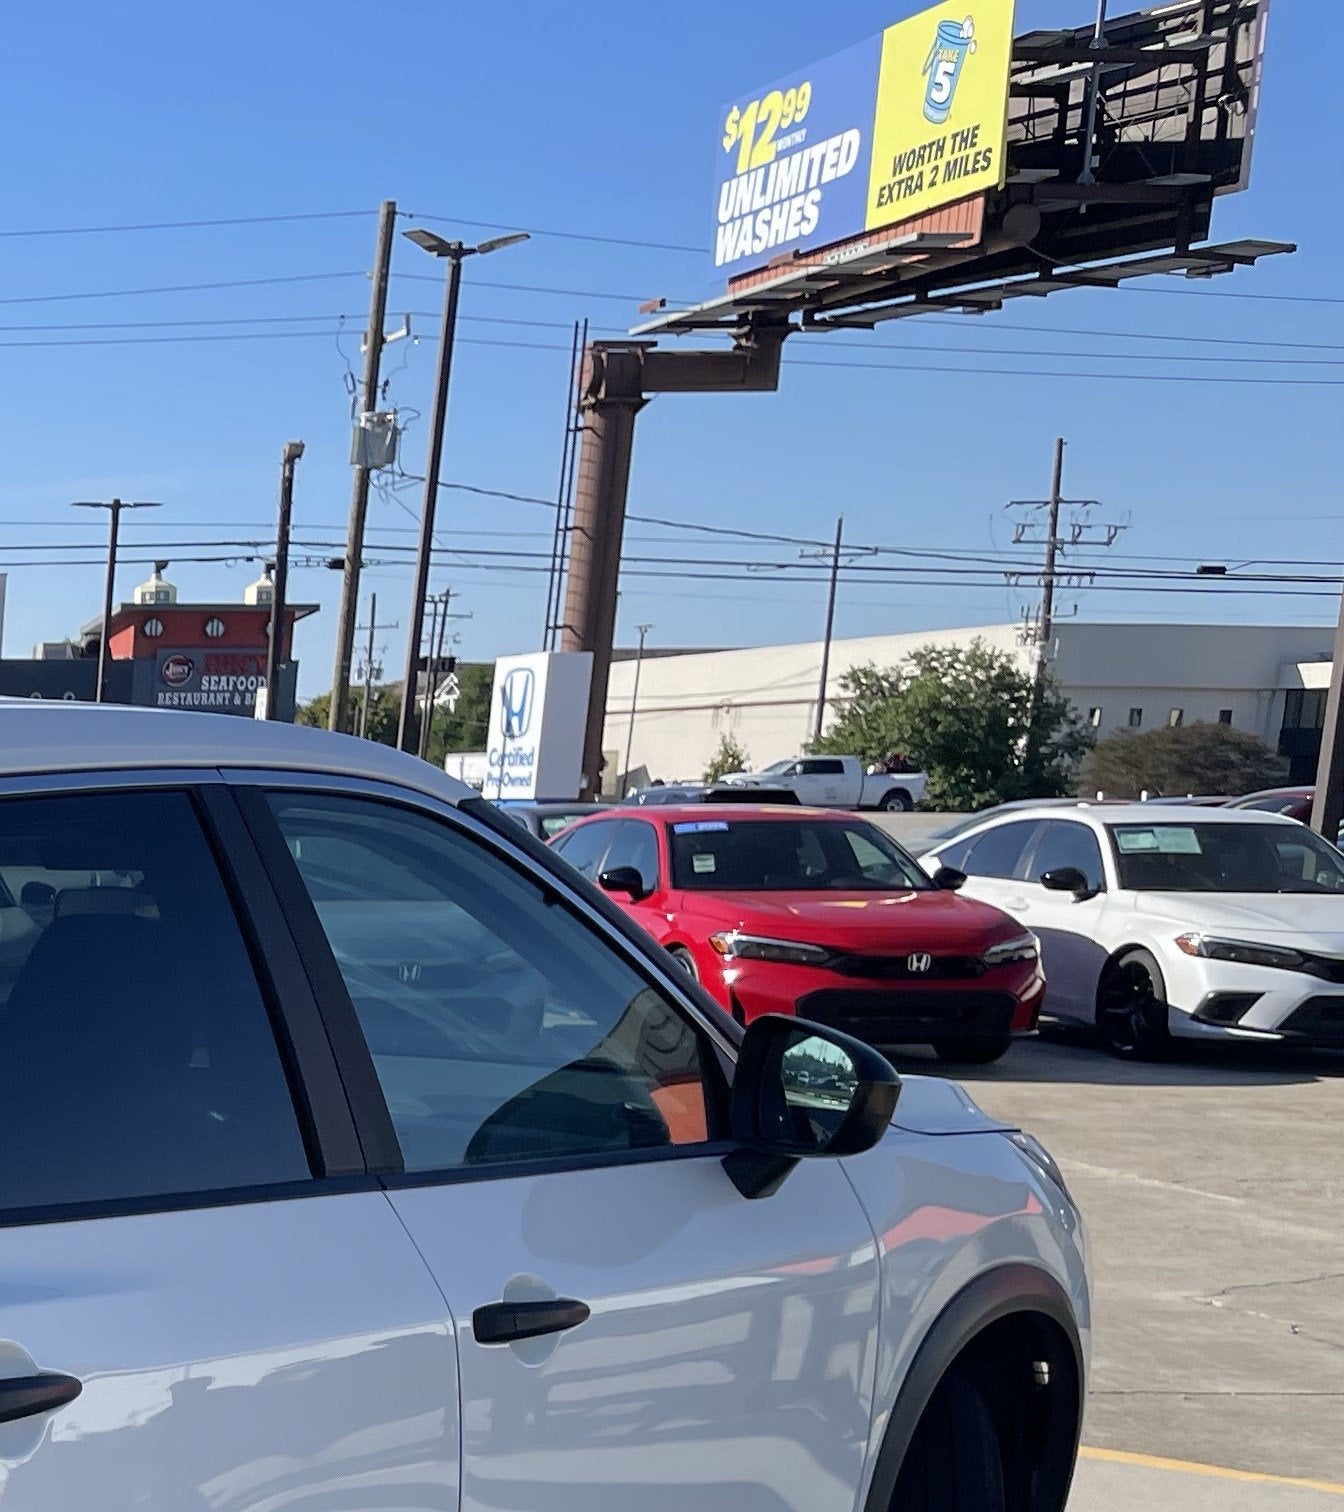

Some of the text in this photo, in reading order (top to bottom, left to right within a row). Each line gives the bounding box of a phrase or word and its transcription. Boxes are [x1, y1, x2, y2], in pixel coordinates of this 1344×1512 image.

[937, 49, 958, 63] TAKE
[930, 61, 957, 104] 5
[891, 124, 981, 178] WORTH THE
[718, 128, 861, 224] UNLIMITED
[876, 147, 993, 208] EXTRA 2 MILES
[715, 189, 822, 267] WASHES
[157, 692, 231, 706] RESTAURANT
[201, 675, 267, 692] SEAFOOD
